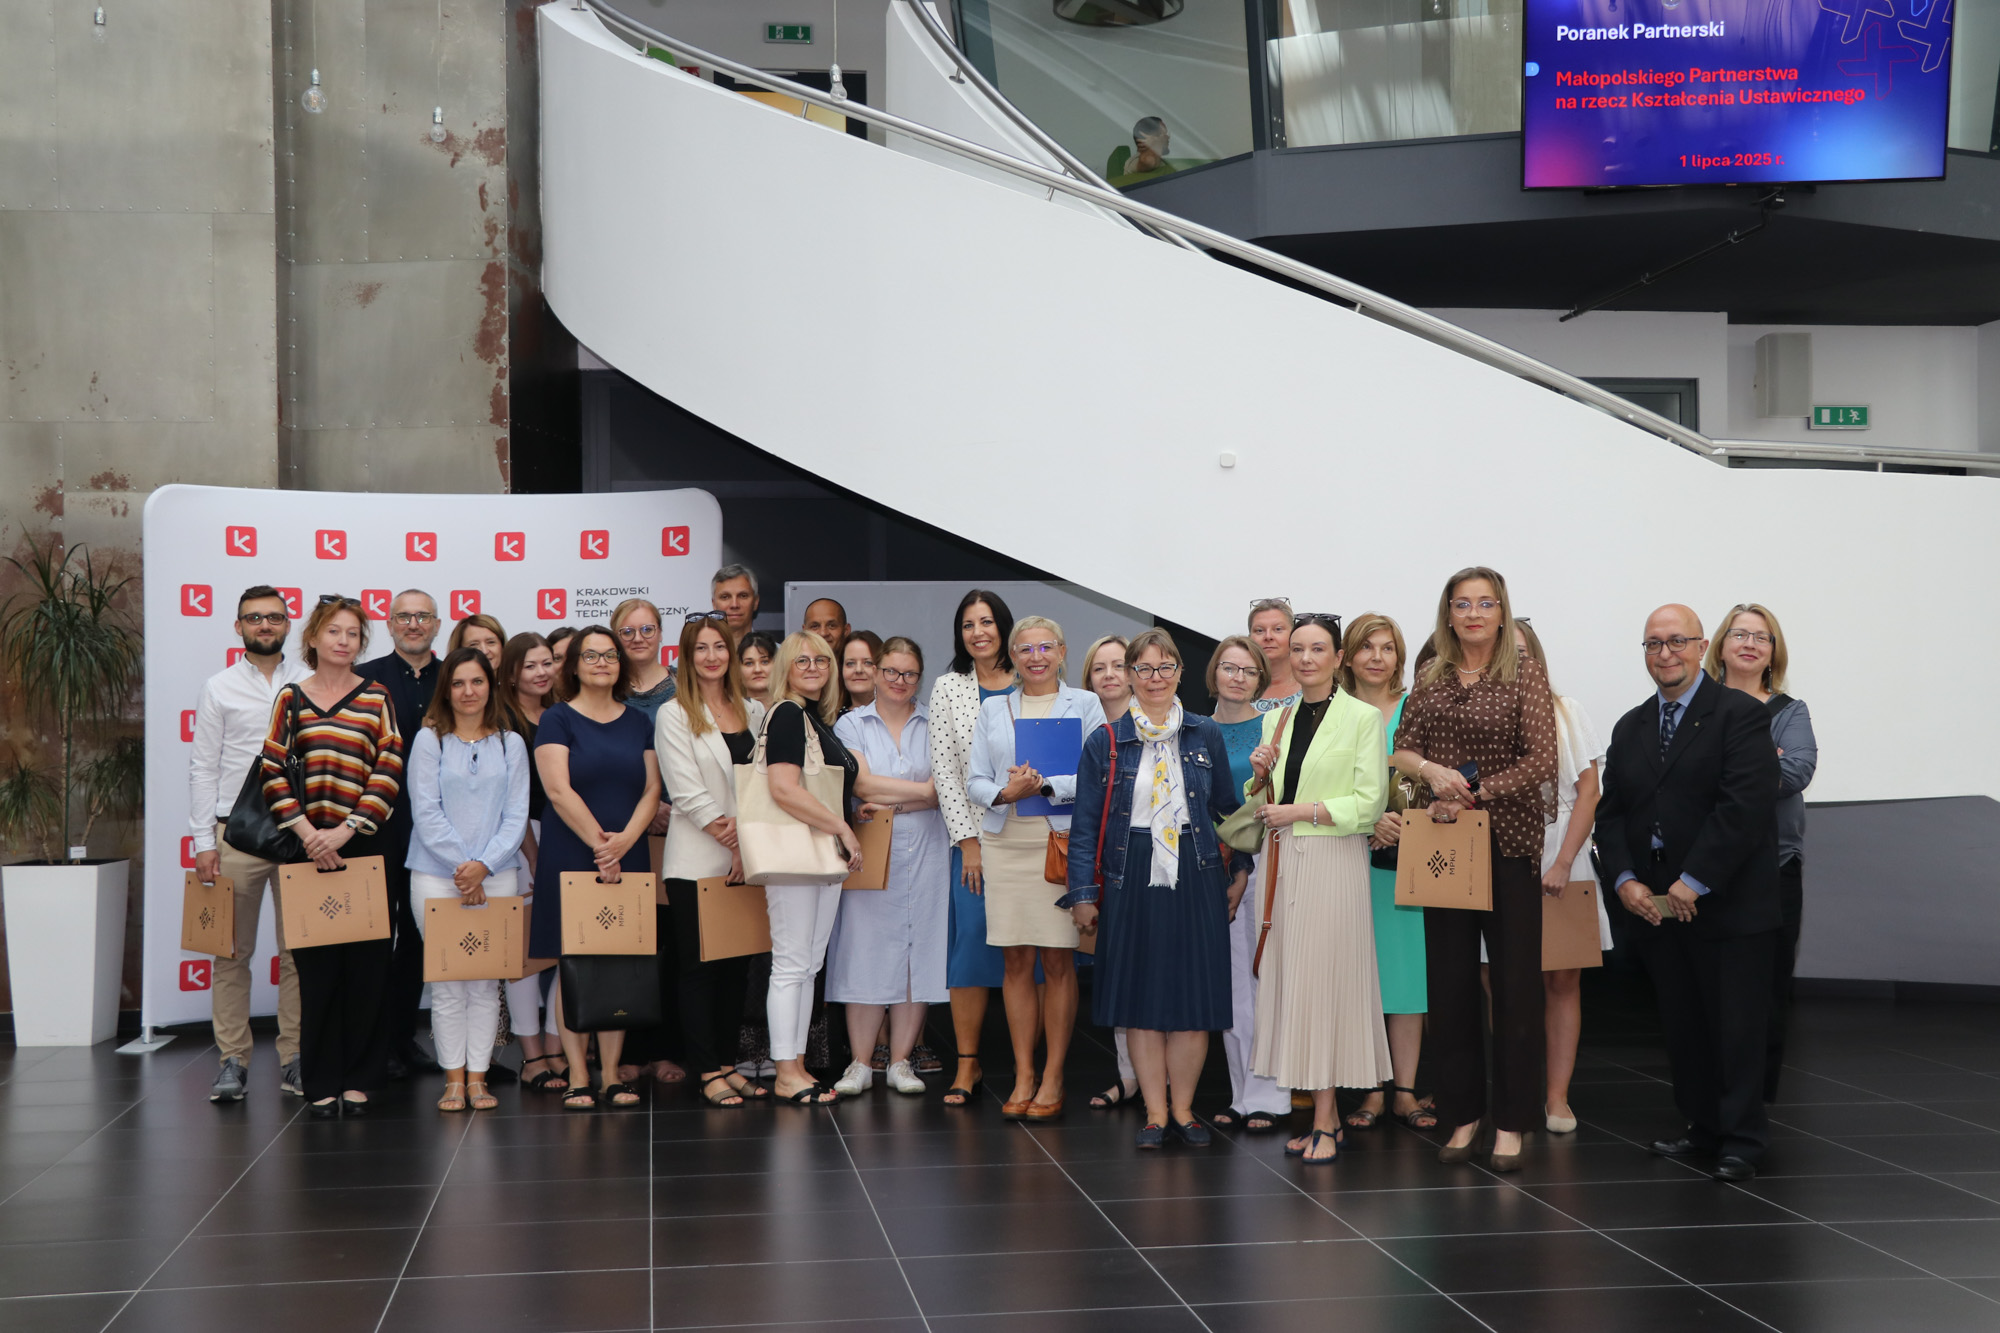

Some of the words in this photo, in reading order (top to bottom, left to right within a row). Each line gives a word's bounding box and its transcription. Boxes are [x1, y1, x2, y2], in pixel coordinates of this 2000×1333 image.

[1556, 23, 1629, 41] Poranek
[1633, 21, 1725, 39] Partnerski
[1556, 69, 1685, 88] Małopolskiego
[1689, 67, 1798, 83] Partnerstwa
[1555, 97, 1577, 109] na
[1581, 96, 1627, 109] rzecz
[1631, 90, 1735, 107] Kształcenia
[1739, 88, 1865, 105] Ustawicznego
[1679, 155, 1688, 168] 1
[1692, 154, 1731, 170] lipca
[1734, 153, 1772, 166] 2025
[1775, 155, 1785, 165] r.
[576, 587, 649, 596] KRAKOWSKI
[576, 599, 608, 607] PARK
[344, 892, 352, 915] MPKU
